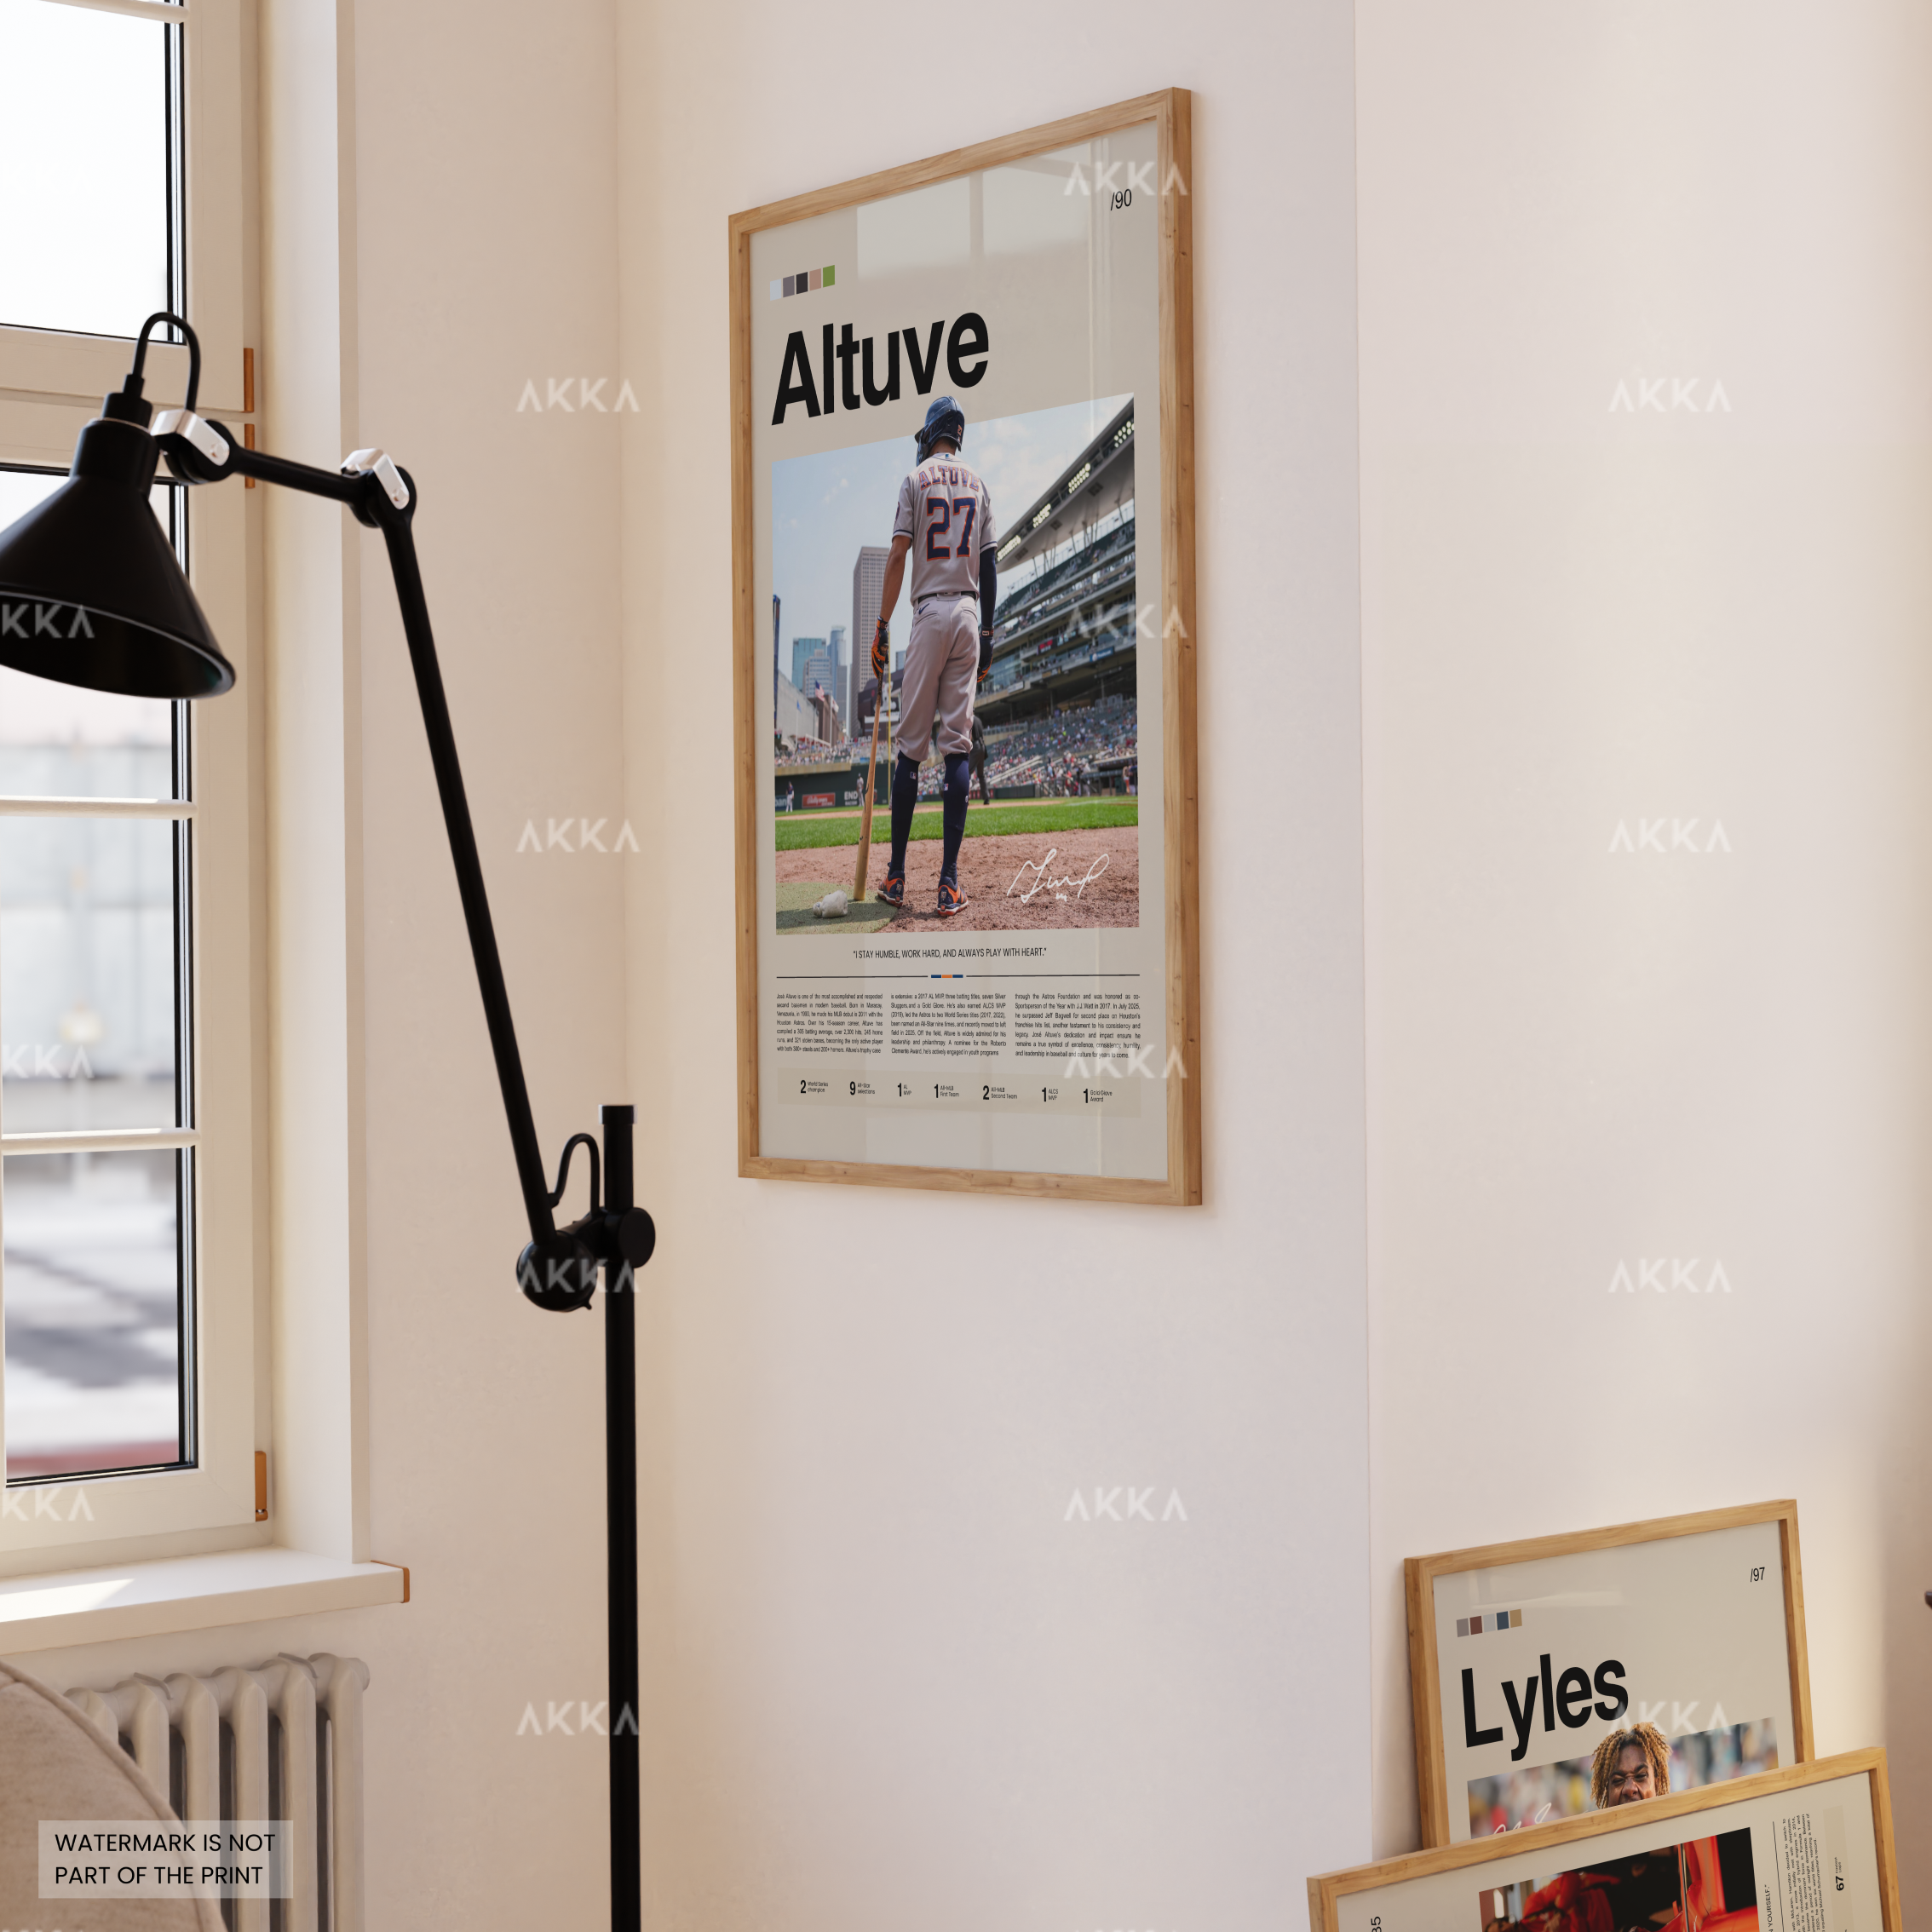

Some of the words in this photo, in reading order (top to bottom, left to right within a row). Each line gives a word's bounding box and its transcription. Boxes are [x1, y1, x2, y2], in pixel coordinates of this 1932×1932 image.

[1110, 188, 1132, 211] /90
[772, 312, 989, 426] Altuve
[918, 465, 980, 492] ALTUVE
[927, 497, 976, 562] 27
[844, 791, 858, 800] END
[859, 950, 874, 958] STAY
[876, 950, 900, 959] HUMBLE,
[902, 949, 921, 958] WORK
[923, 949, 941, 959] HARD,
[943, 949, 957, 957] AND
[958, 948, 985, 957] ALWAYS
[986, 948, 1002, 957] PLAY
[1003, 947, 1020, 957] WITH
[1021, 947, 1047, 957] HEART."
[800, 1079, 806, 1094] 2
[849, 1081, 856, 1095] 9
[897, 1083, 902, 1097] 1
[934, 1084, 939, 1098] 1
[982, 1085, 990, 1100] 2
[1042, 1087, 1046, 1102] 1
[1083, 1089, 1089, 1103] 1
[1750, 1566, 1766, 1584] /97
[1462, 1653, 1628, 1762] Lyles
[1835, 1876, 1844, 1891] 67
[1764, 1884, 1773, 1927] YOURSELF."
